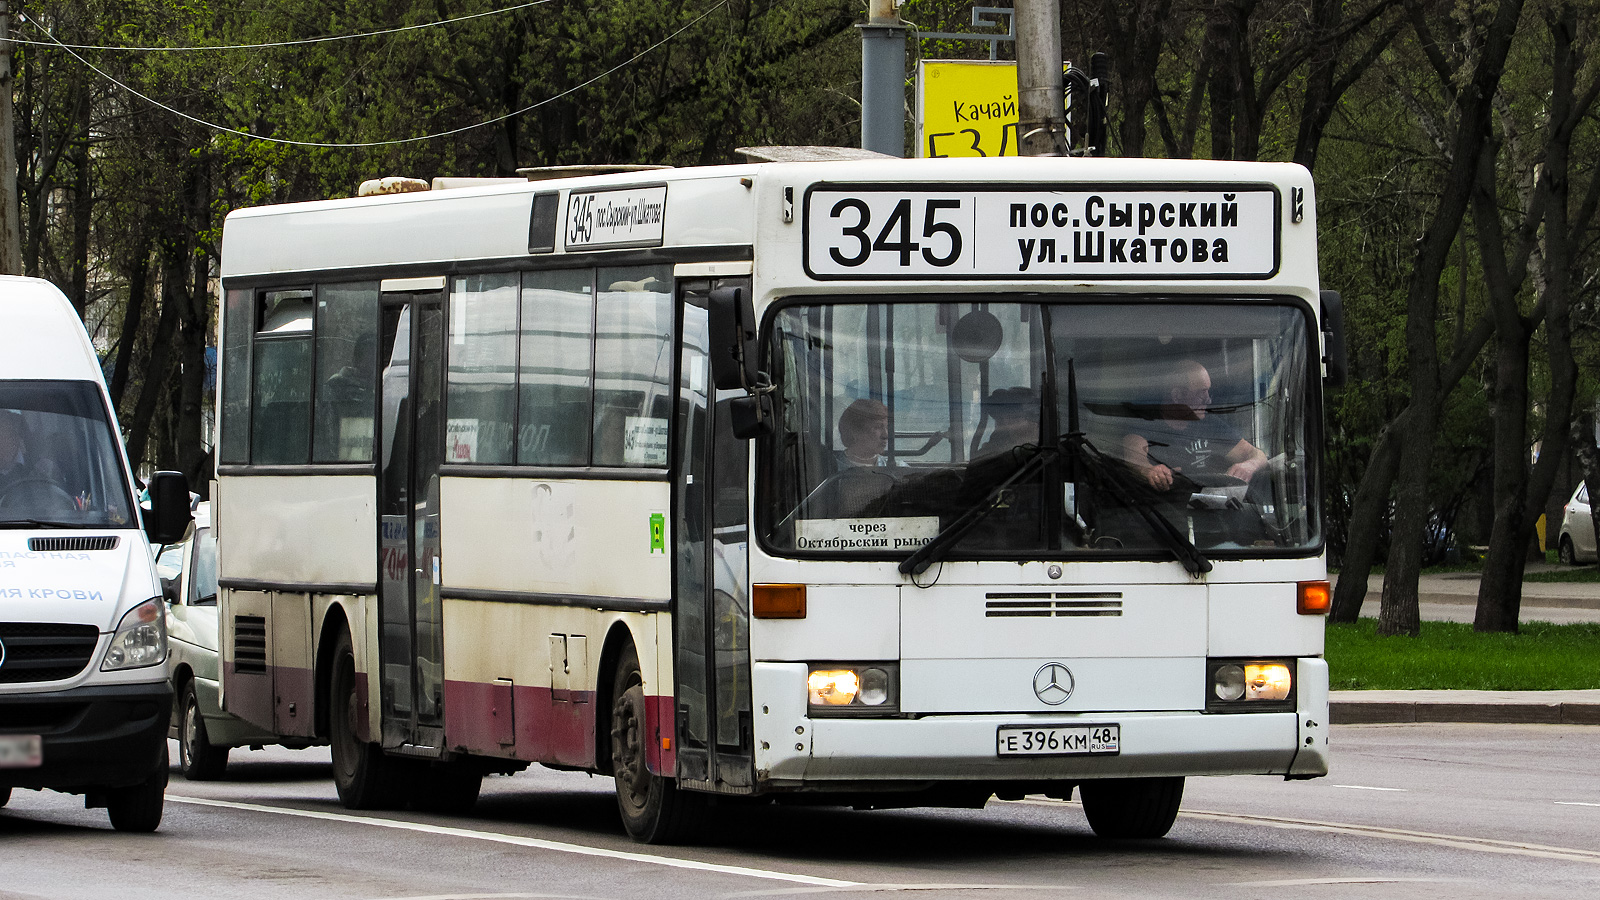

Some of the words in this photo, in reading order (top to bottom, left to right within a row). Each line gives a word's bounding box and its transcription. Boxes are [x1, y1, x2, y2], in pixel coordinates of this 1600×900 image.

[570, 194, 596, 243] 345
[1009, 193, 1239, 238] пос.Сырский
[828, 197, 963, 268] 345
[1017, 230, 1230, 271] ул.Шкатова
[848, 523, 887, 535] через
[893, 537, 936, 549] рыно
[27, 588, 104, 602] КРОВИ
[1092, 728, 1111, 744] 48
